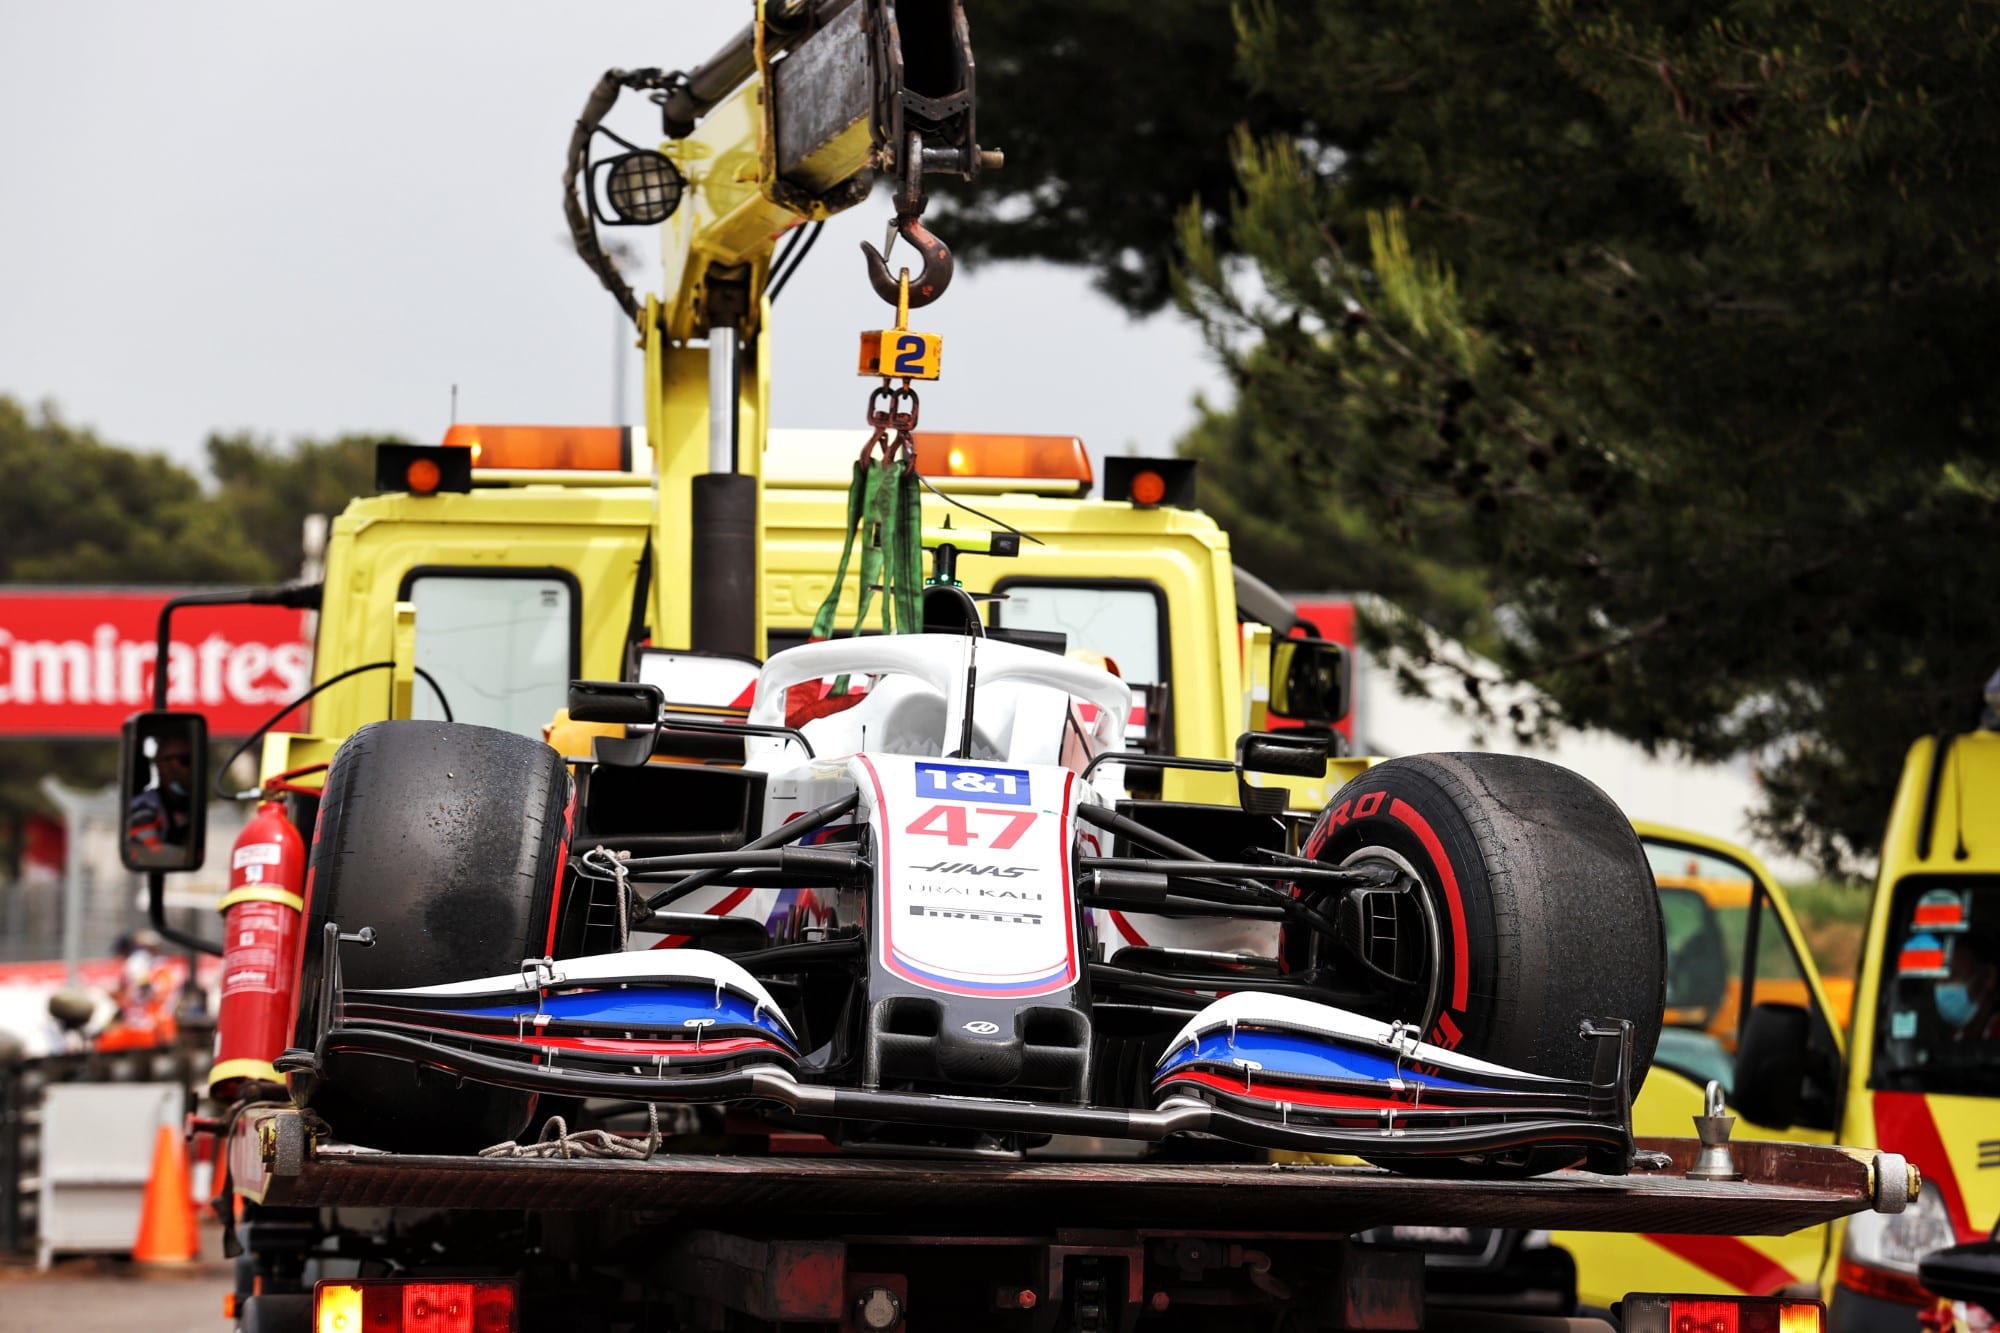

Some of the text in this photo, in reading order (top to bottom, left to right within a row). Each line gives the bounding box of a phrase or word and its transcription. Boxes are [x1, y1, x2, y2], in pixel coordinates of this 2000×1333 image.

[895, 335, 926, 374] 2
[0, 624, 309, 705] mirates
[924, 769, 1017, 795] 1&1
[905, 804, 1038, 850] 47
[1306, 791, 1388, 860] ERO
[908, 861, 1040, 878] HAAS
[908, 884, 1042, 901] URALKALI
